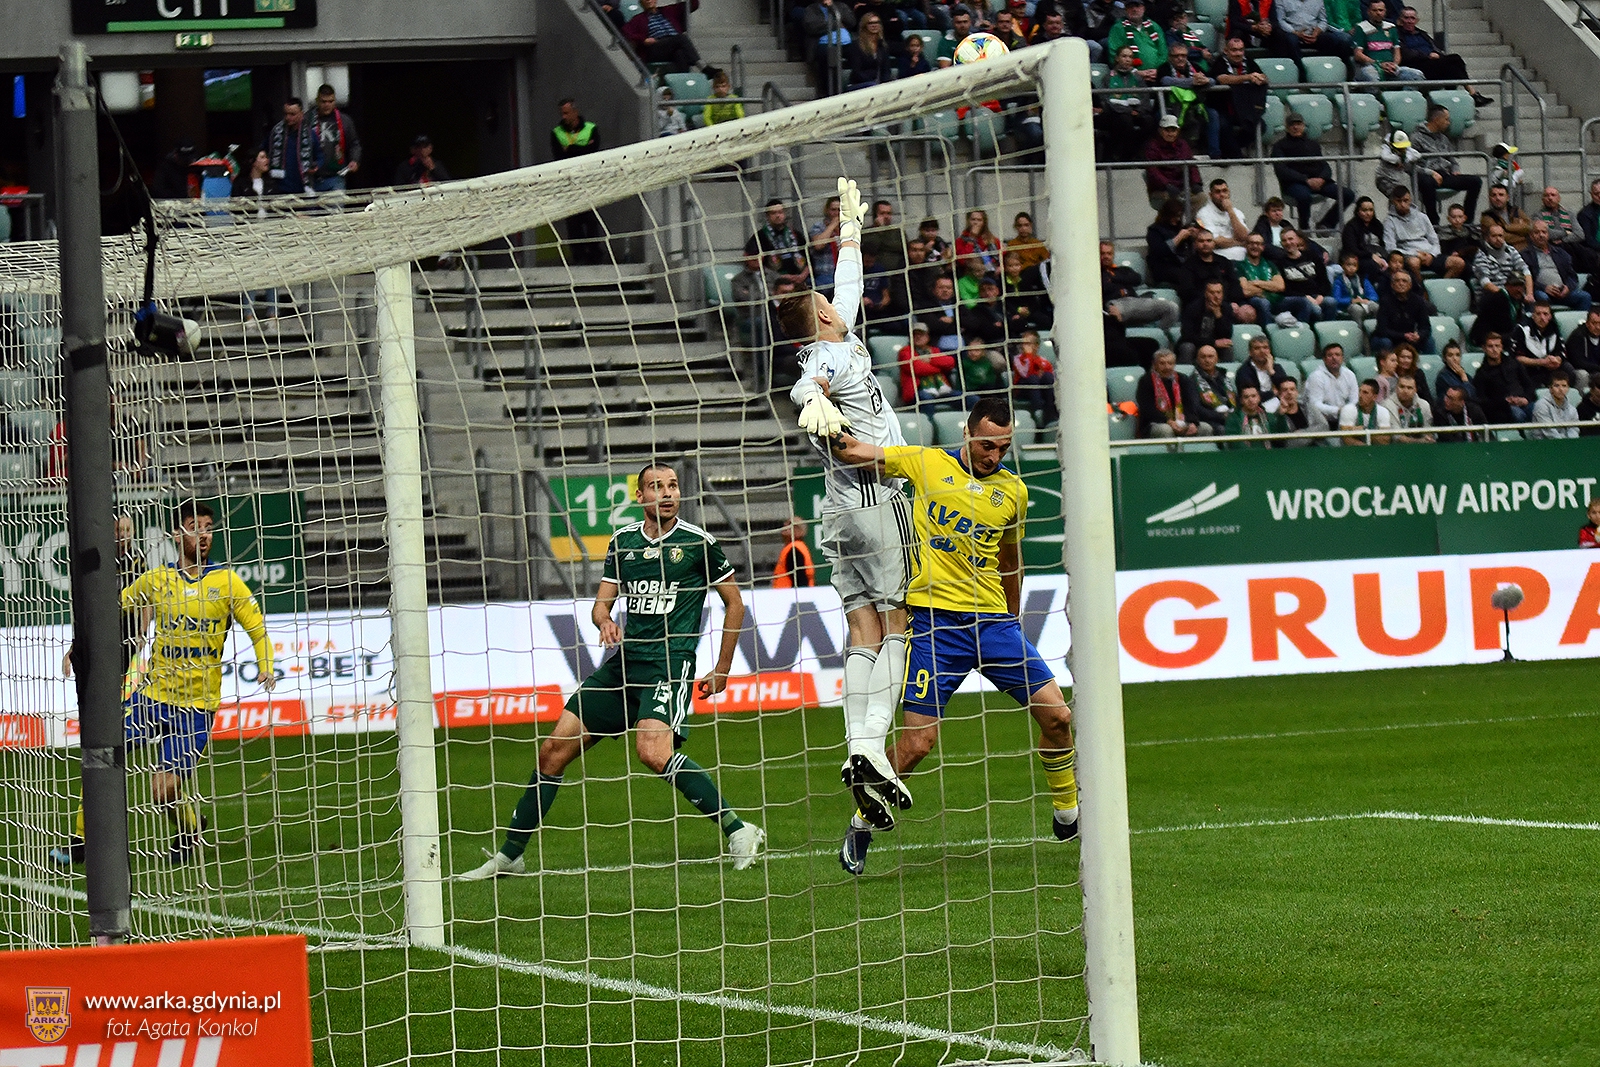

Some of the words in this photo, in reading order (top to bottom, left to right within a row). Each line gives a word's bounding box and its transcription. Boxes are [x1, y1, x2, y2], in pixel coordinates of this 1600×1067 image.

[574, 483, 637, 528] 12
[1266, 483, 1448, 521] WROCŁAW
[1457, 477, 1597, 515] AIRPORT
[626, 580, 680, 595] NOBLE
[628, 595, 678, 615] BET
[274, 640, 336, 652] RUPA
[915, 669, 930, 699] 9
[325, 704, 397, 723] STIH
[453, 694, 549, 718] STIHL
[217, 707, 292, 729] TIHL
